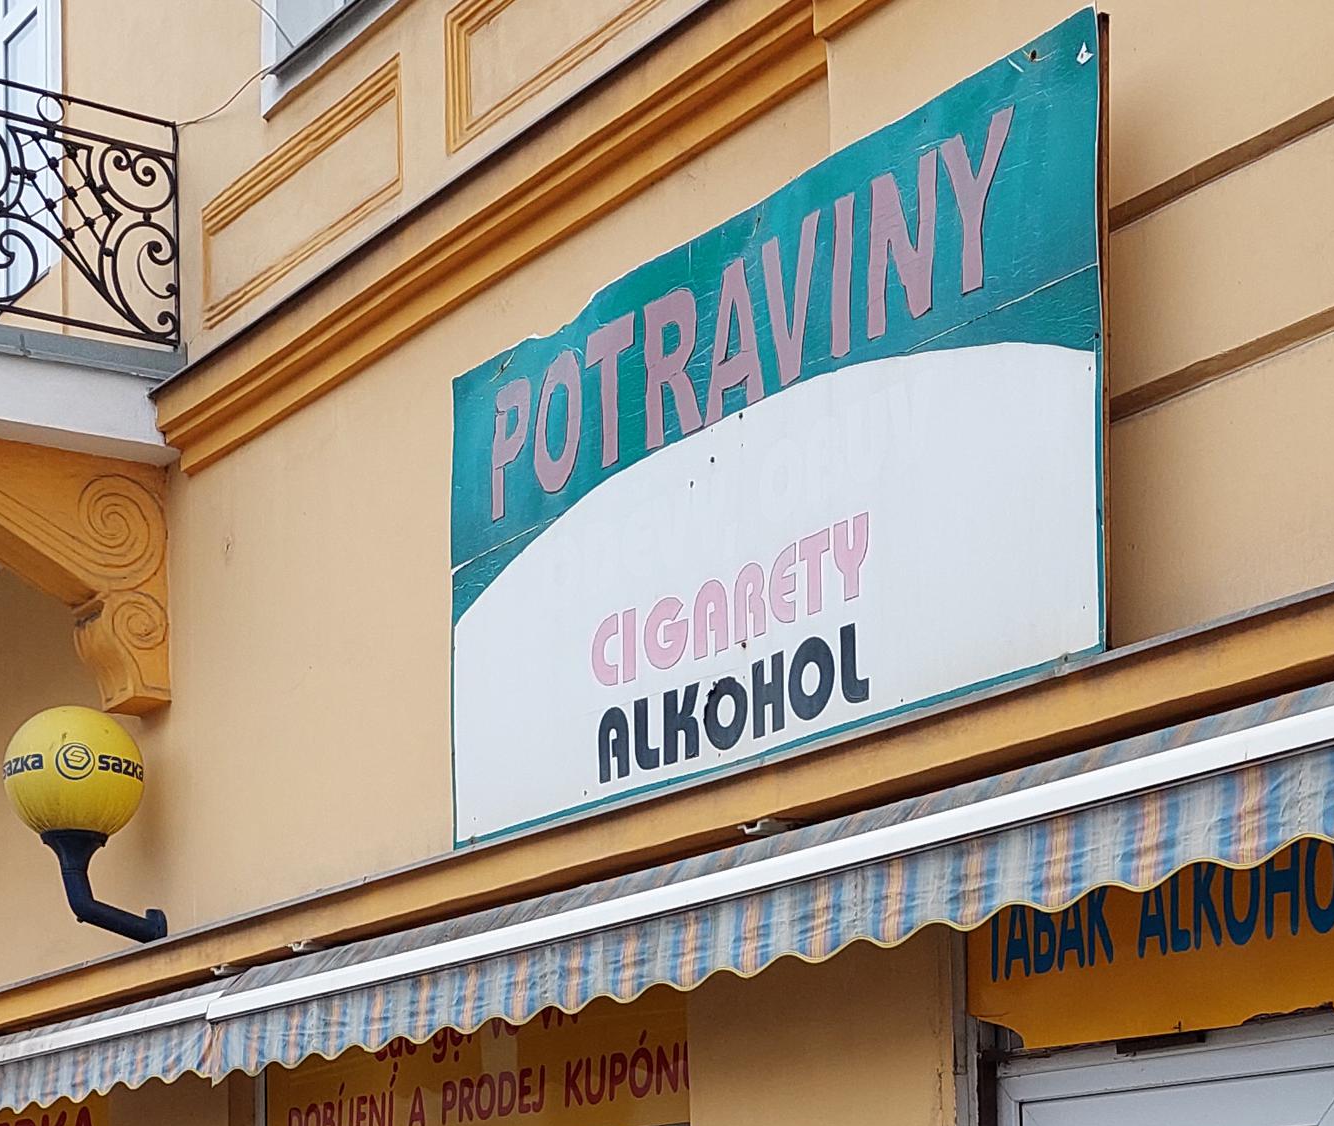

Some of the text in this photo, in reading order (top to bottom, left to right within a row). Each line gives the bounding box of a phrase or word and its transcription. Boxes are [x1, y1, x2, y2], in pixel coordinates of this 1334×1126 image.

[492, 104, 1015, 522] POTRAVINY
[591, 511, 870, 686] CIGARETY
[596, 622, 870, 784] ALKOHOL
[440, 1065, 548, 1126] PRODEJ
